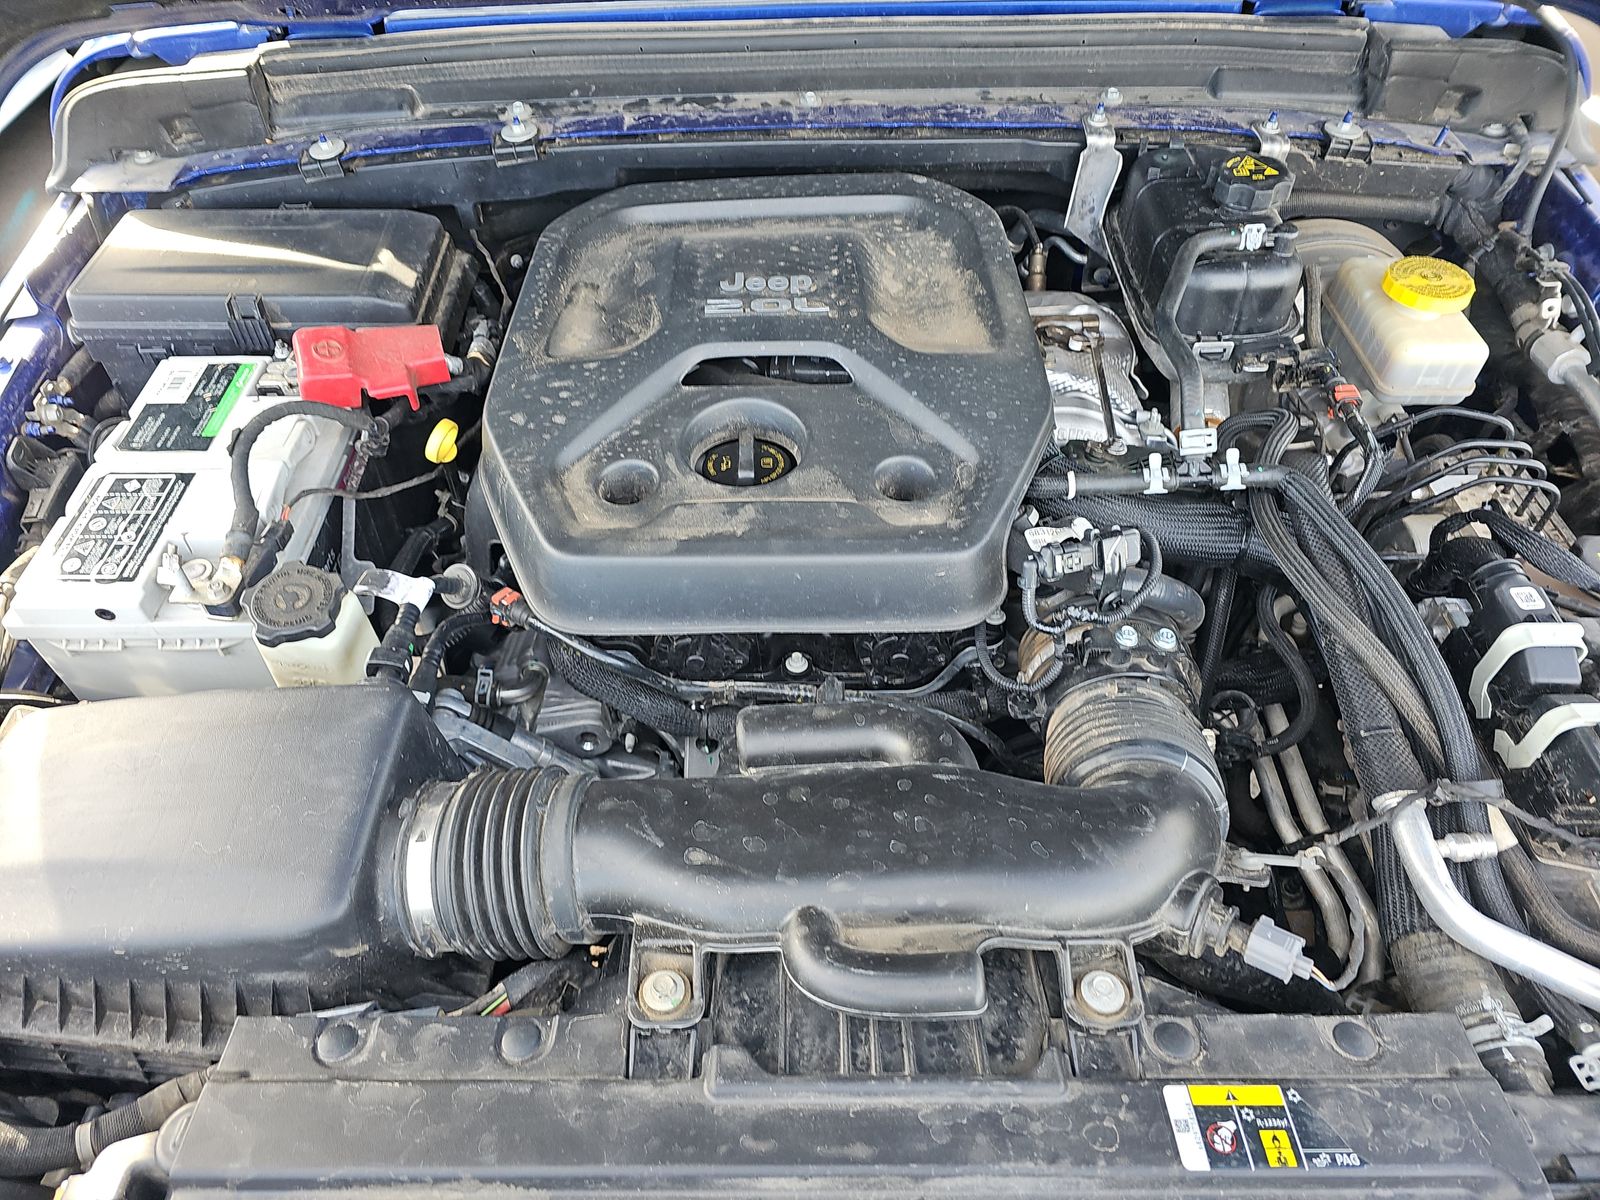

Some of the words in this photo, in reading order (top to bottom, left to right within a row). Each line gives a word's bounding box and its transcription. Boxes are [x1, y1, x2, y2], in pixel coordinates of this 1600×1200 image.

[719, 271, 812, 295] Jeep
[704, 297, 830, 316] 2.0L
[1334, 1153, 1360, 1166] PAG
